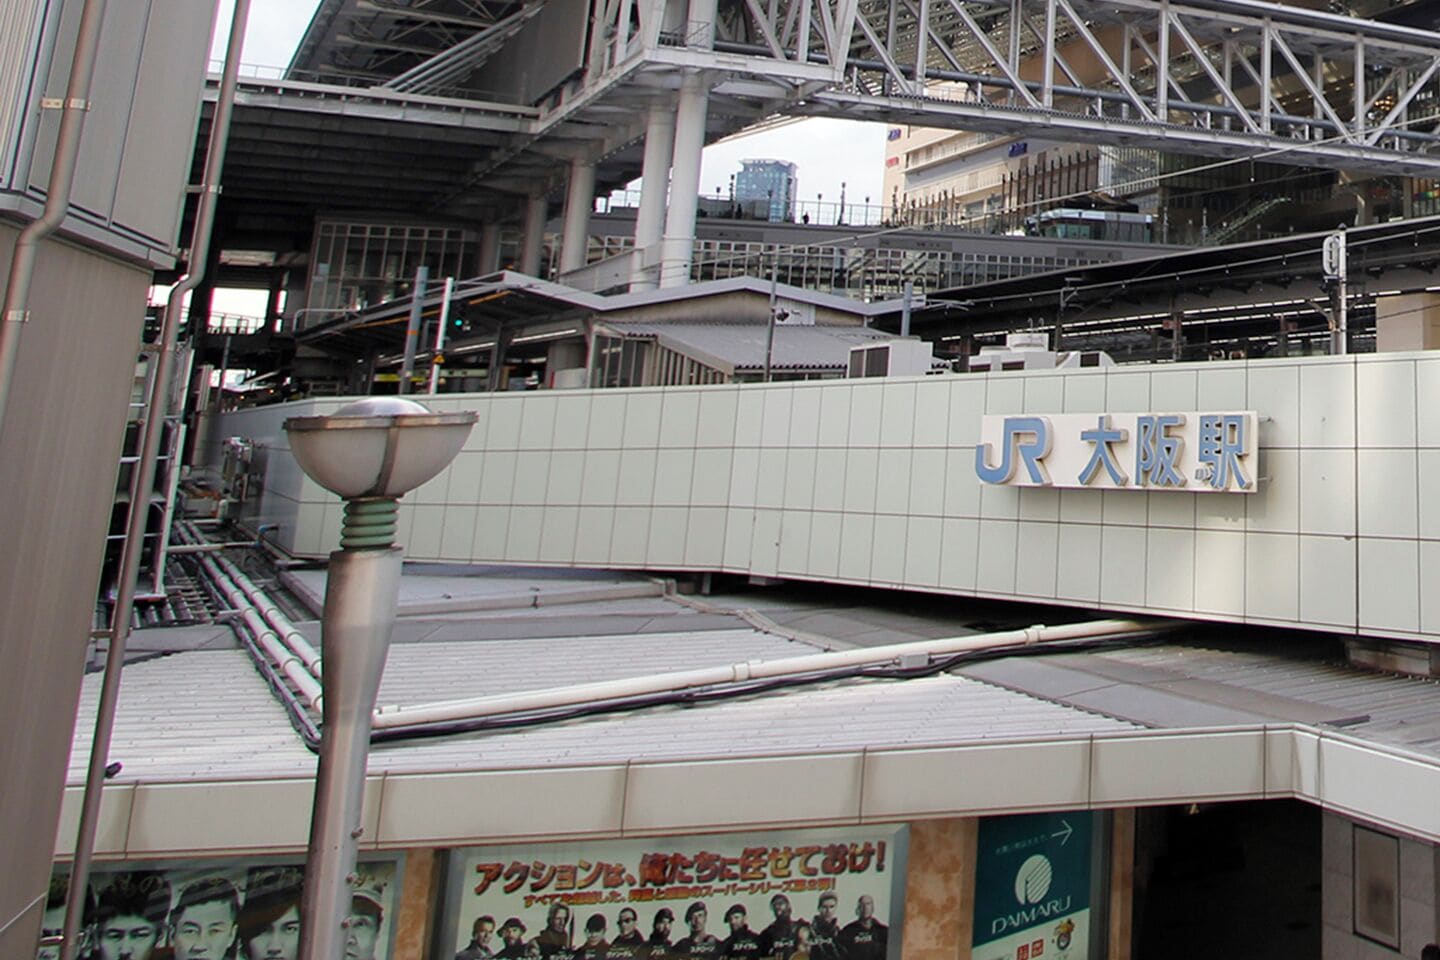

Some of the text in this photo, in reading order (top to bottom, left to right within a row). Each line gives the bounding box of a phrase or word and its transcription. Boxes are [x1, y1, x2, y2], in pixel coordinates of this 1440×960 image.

[974, 414, 1253, 490] JR 大阪駅
[991, 895, 1072, 935] DAIMARU
